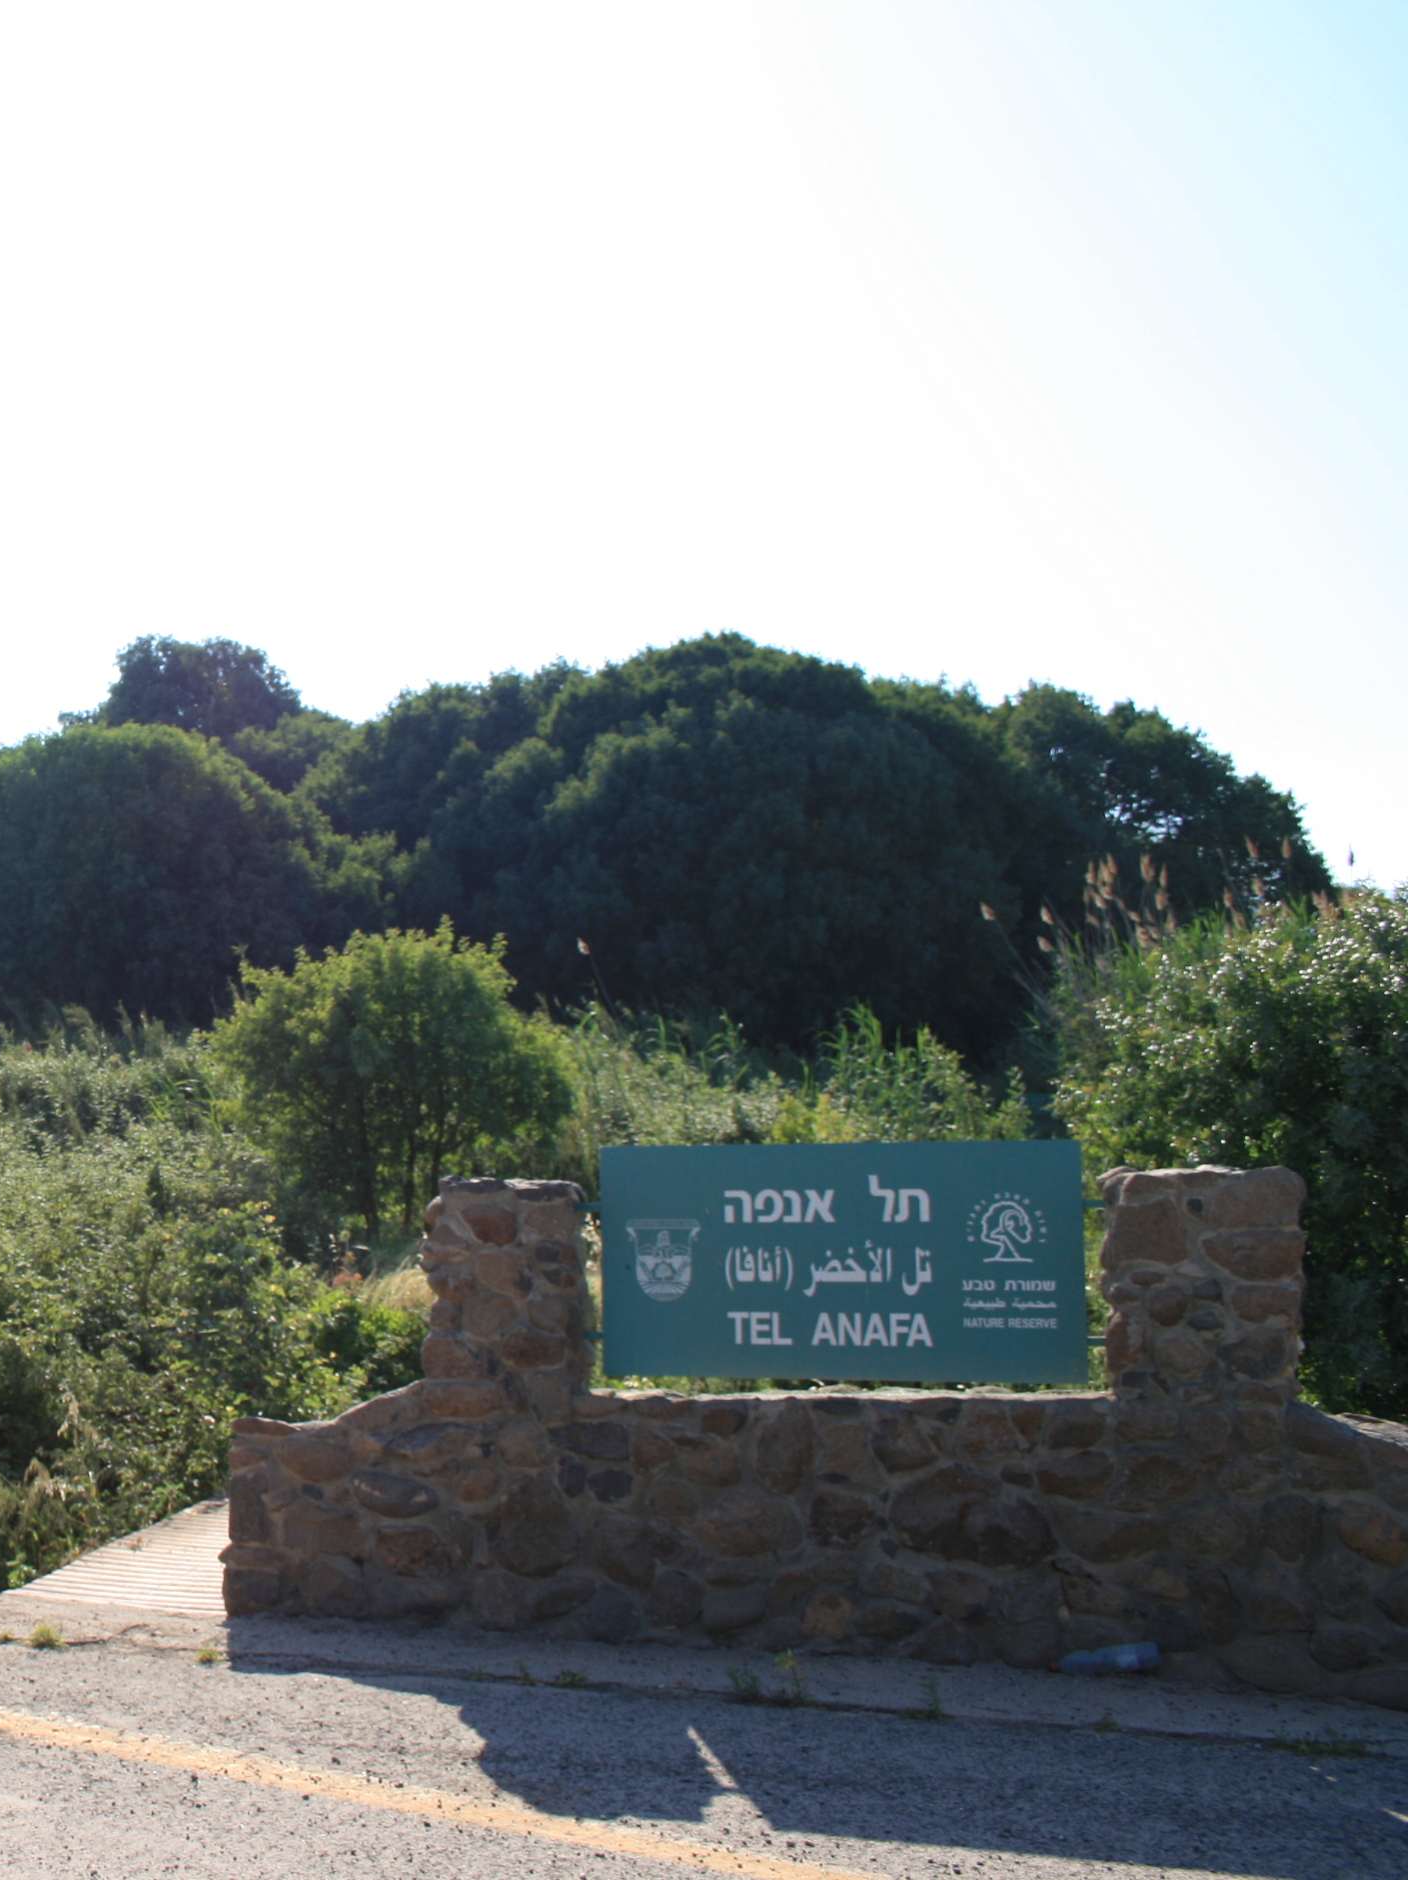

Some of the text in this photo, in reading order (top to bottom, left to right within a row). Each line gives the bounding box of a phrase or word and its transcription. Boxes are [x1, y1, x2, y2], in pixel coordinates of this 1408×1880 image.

[724, 1189, 835, 1223] אנפה
[868, 1174, 930, 1222] תל
[724, 1239, 933, 1297] تل الأخضر (أنافا)
[962, 1280, 1056, 1291] שמורת טבע
[727, 1311, 933, 1347] TEL ANAFA
[963, 1317, 1057, 1329] NATURE RESERVE
